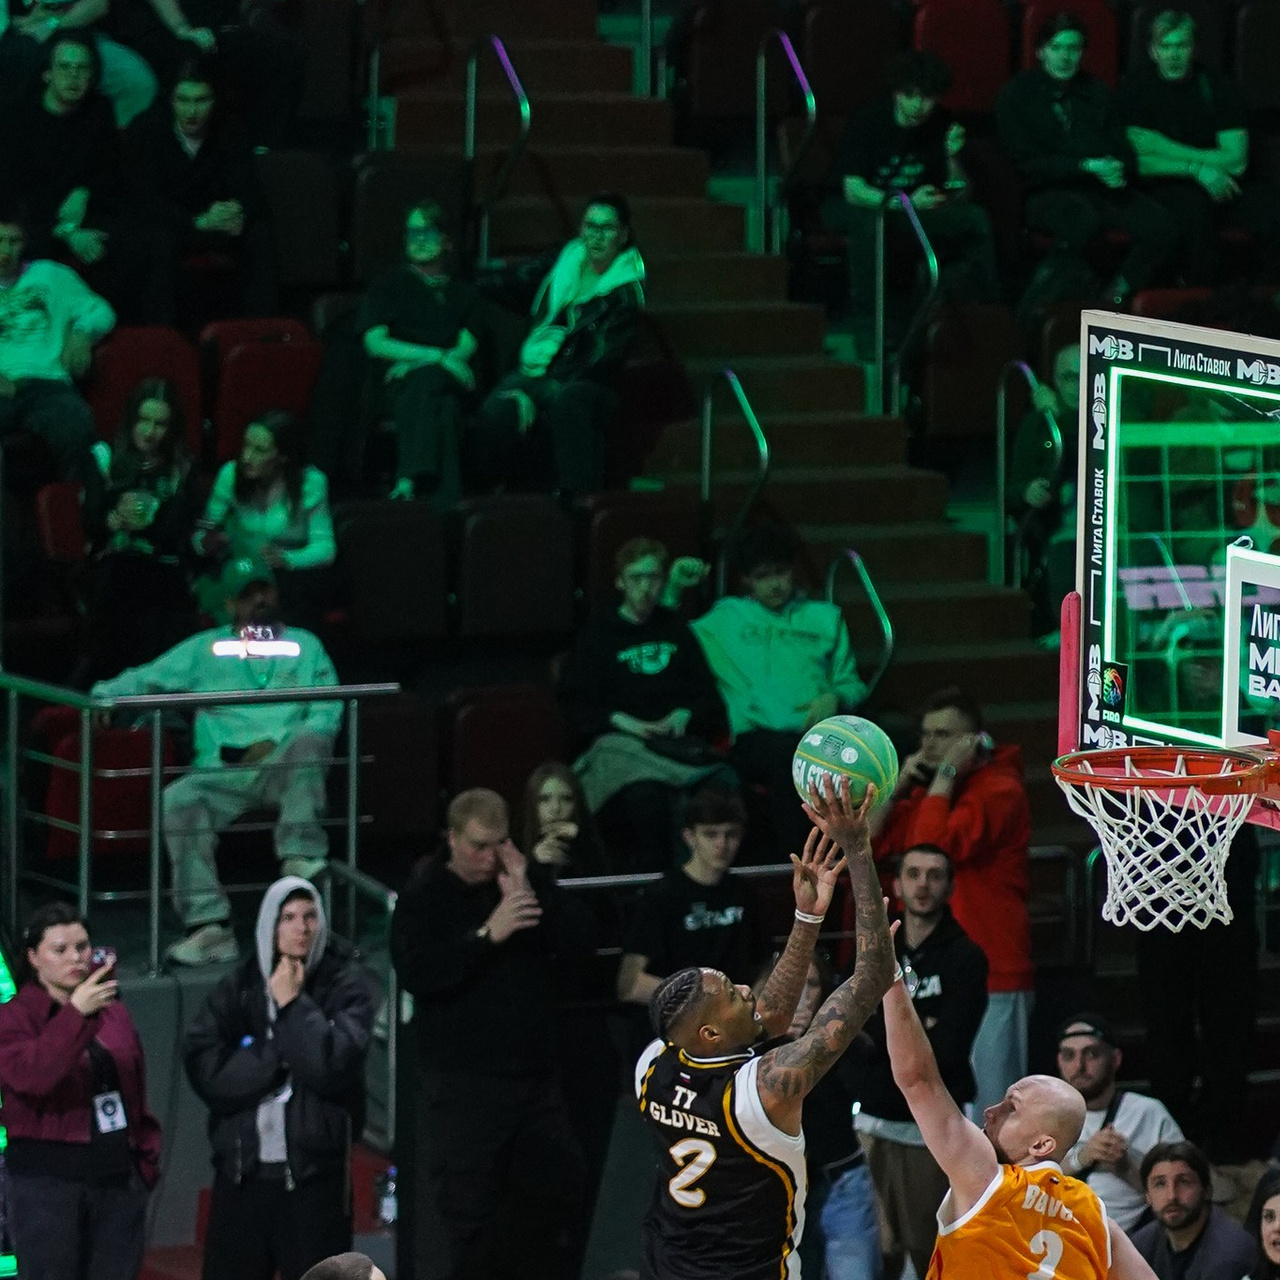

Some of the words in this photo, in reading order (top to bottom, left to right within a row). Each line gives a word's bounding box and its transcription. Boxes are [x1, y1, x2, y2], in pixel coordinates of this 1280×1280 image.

[673, 1084, 698, 1110] TY
[650, 1100, 721, 1138] GLOVER
[668, 1137, 717, 1208] 2
